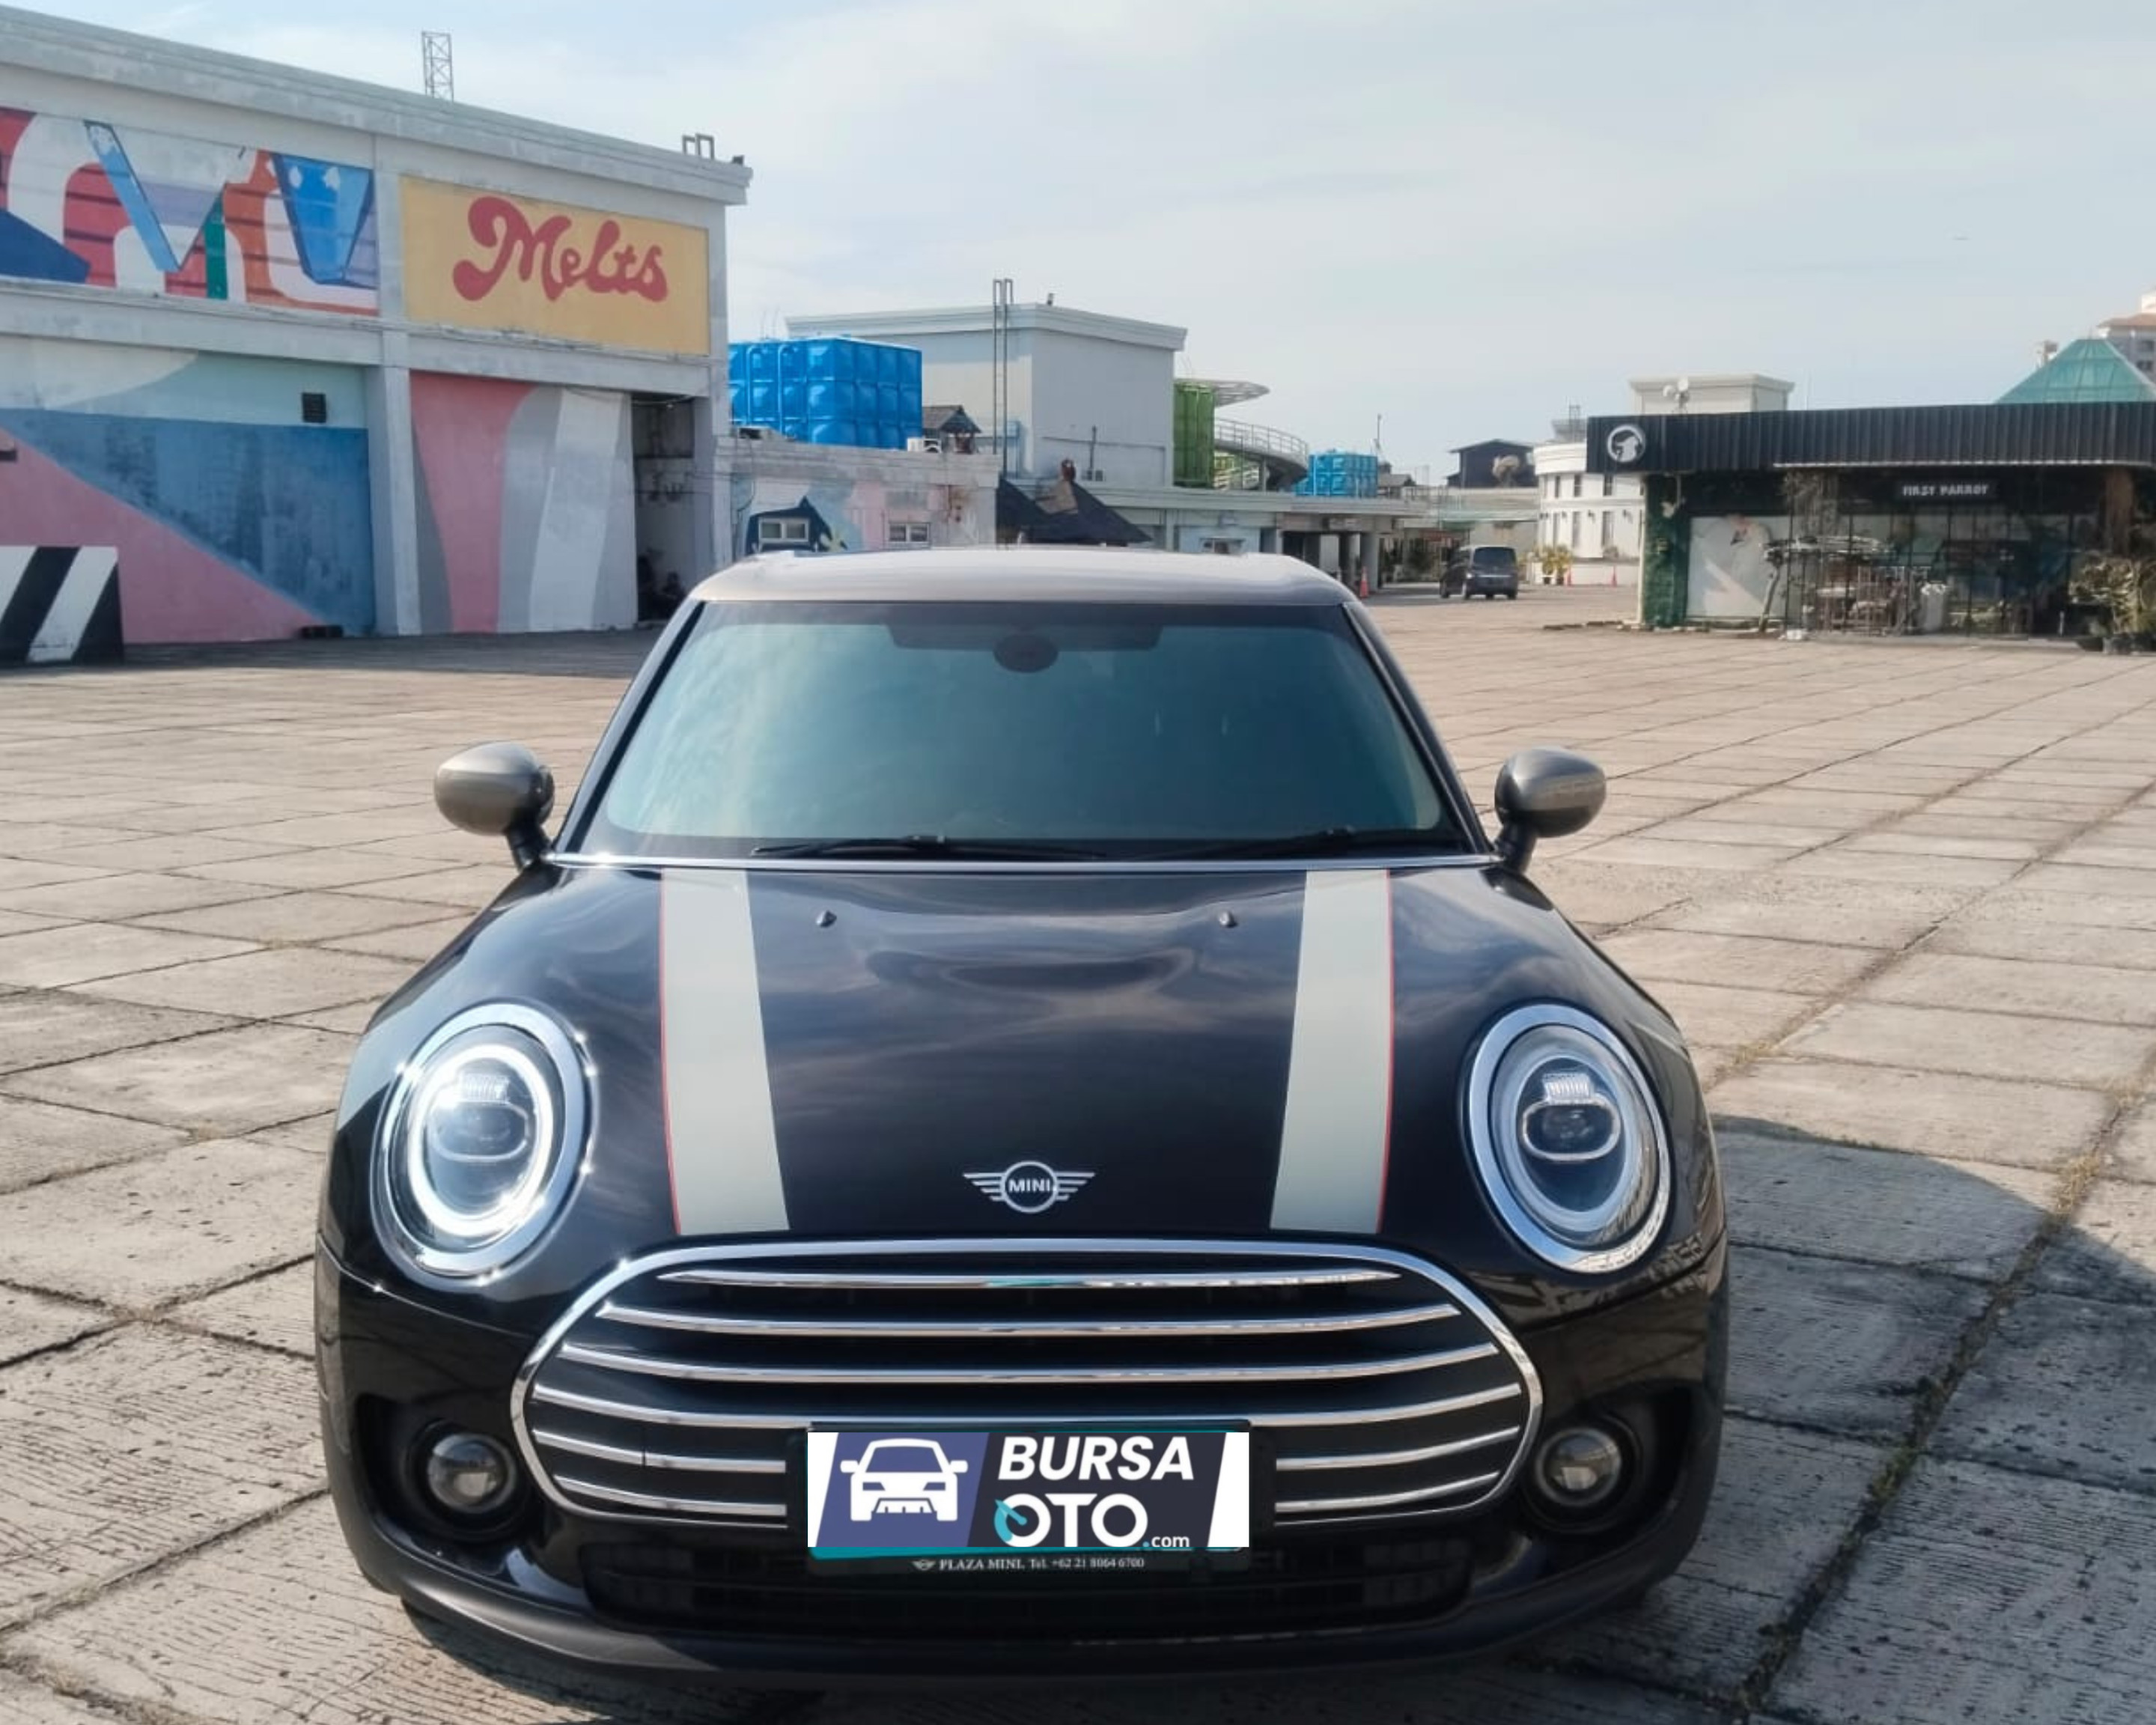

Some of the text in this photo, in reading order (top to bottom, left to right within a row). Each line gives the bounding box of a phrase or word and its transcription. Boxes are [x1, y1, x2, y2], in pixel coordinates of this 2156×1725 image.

[452, 195, 669, 301] Melts
[1009, 1178, 1050, 1192] MINI
[939, 1558, 985, 1571] PLAZA
[1053, 1557, 1071, 1569] +62
[1074, 1557, 1085, 1568] 21
